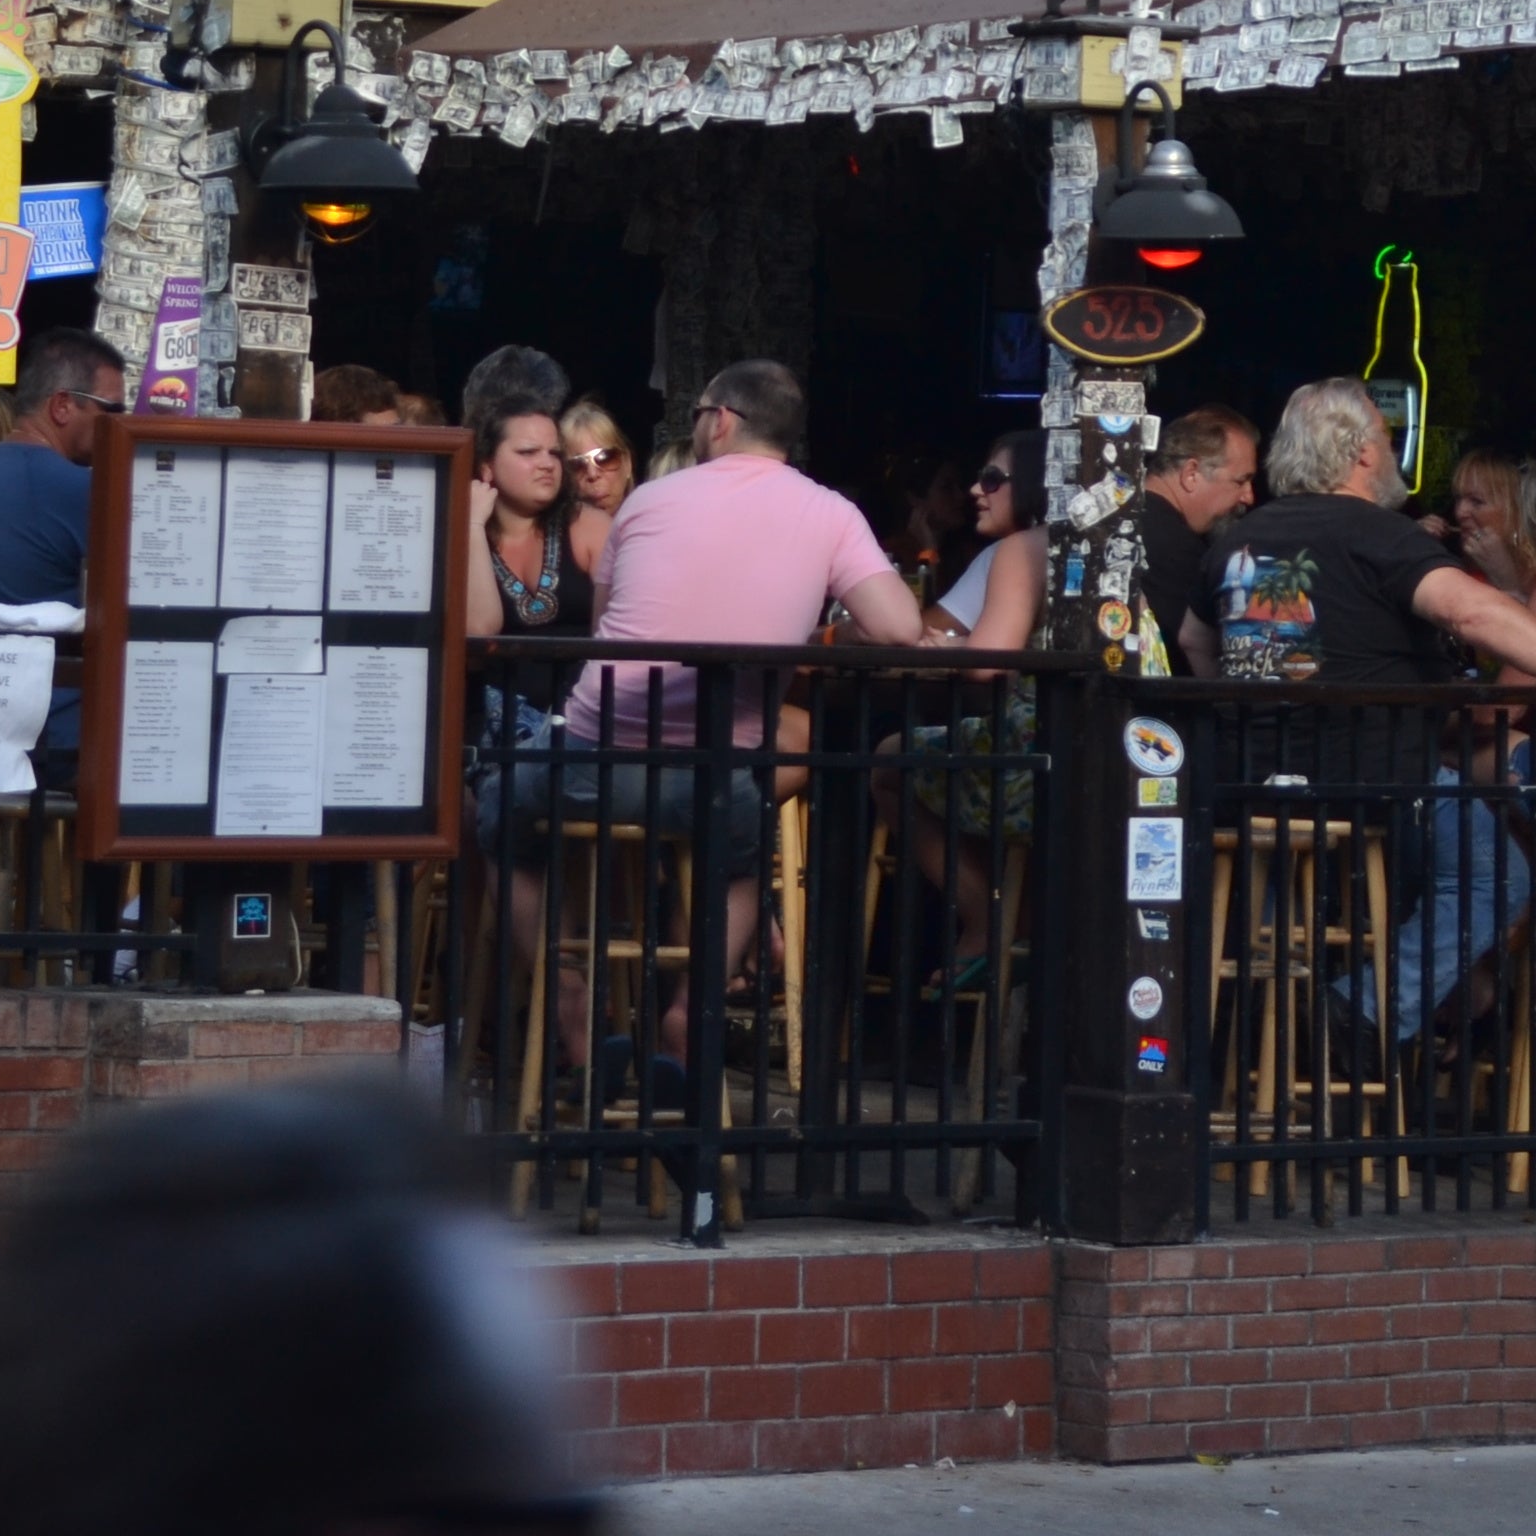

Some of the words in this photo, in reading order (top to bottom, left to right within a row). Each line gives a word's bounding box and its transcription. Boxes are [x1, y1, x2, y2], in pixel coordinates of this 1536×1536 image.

[24, 199, 82, 224] DRINK
[33, 240, 91, 265] DRINK
[165, 296, 198, 308] SPRING
[1082, 292, 1164, 342] 525
